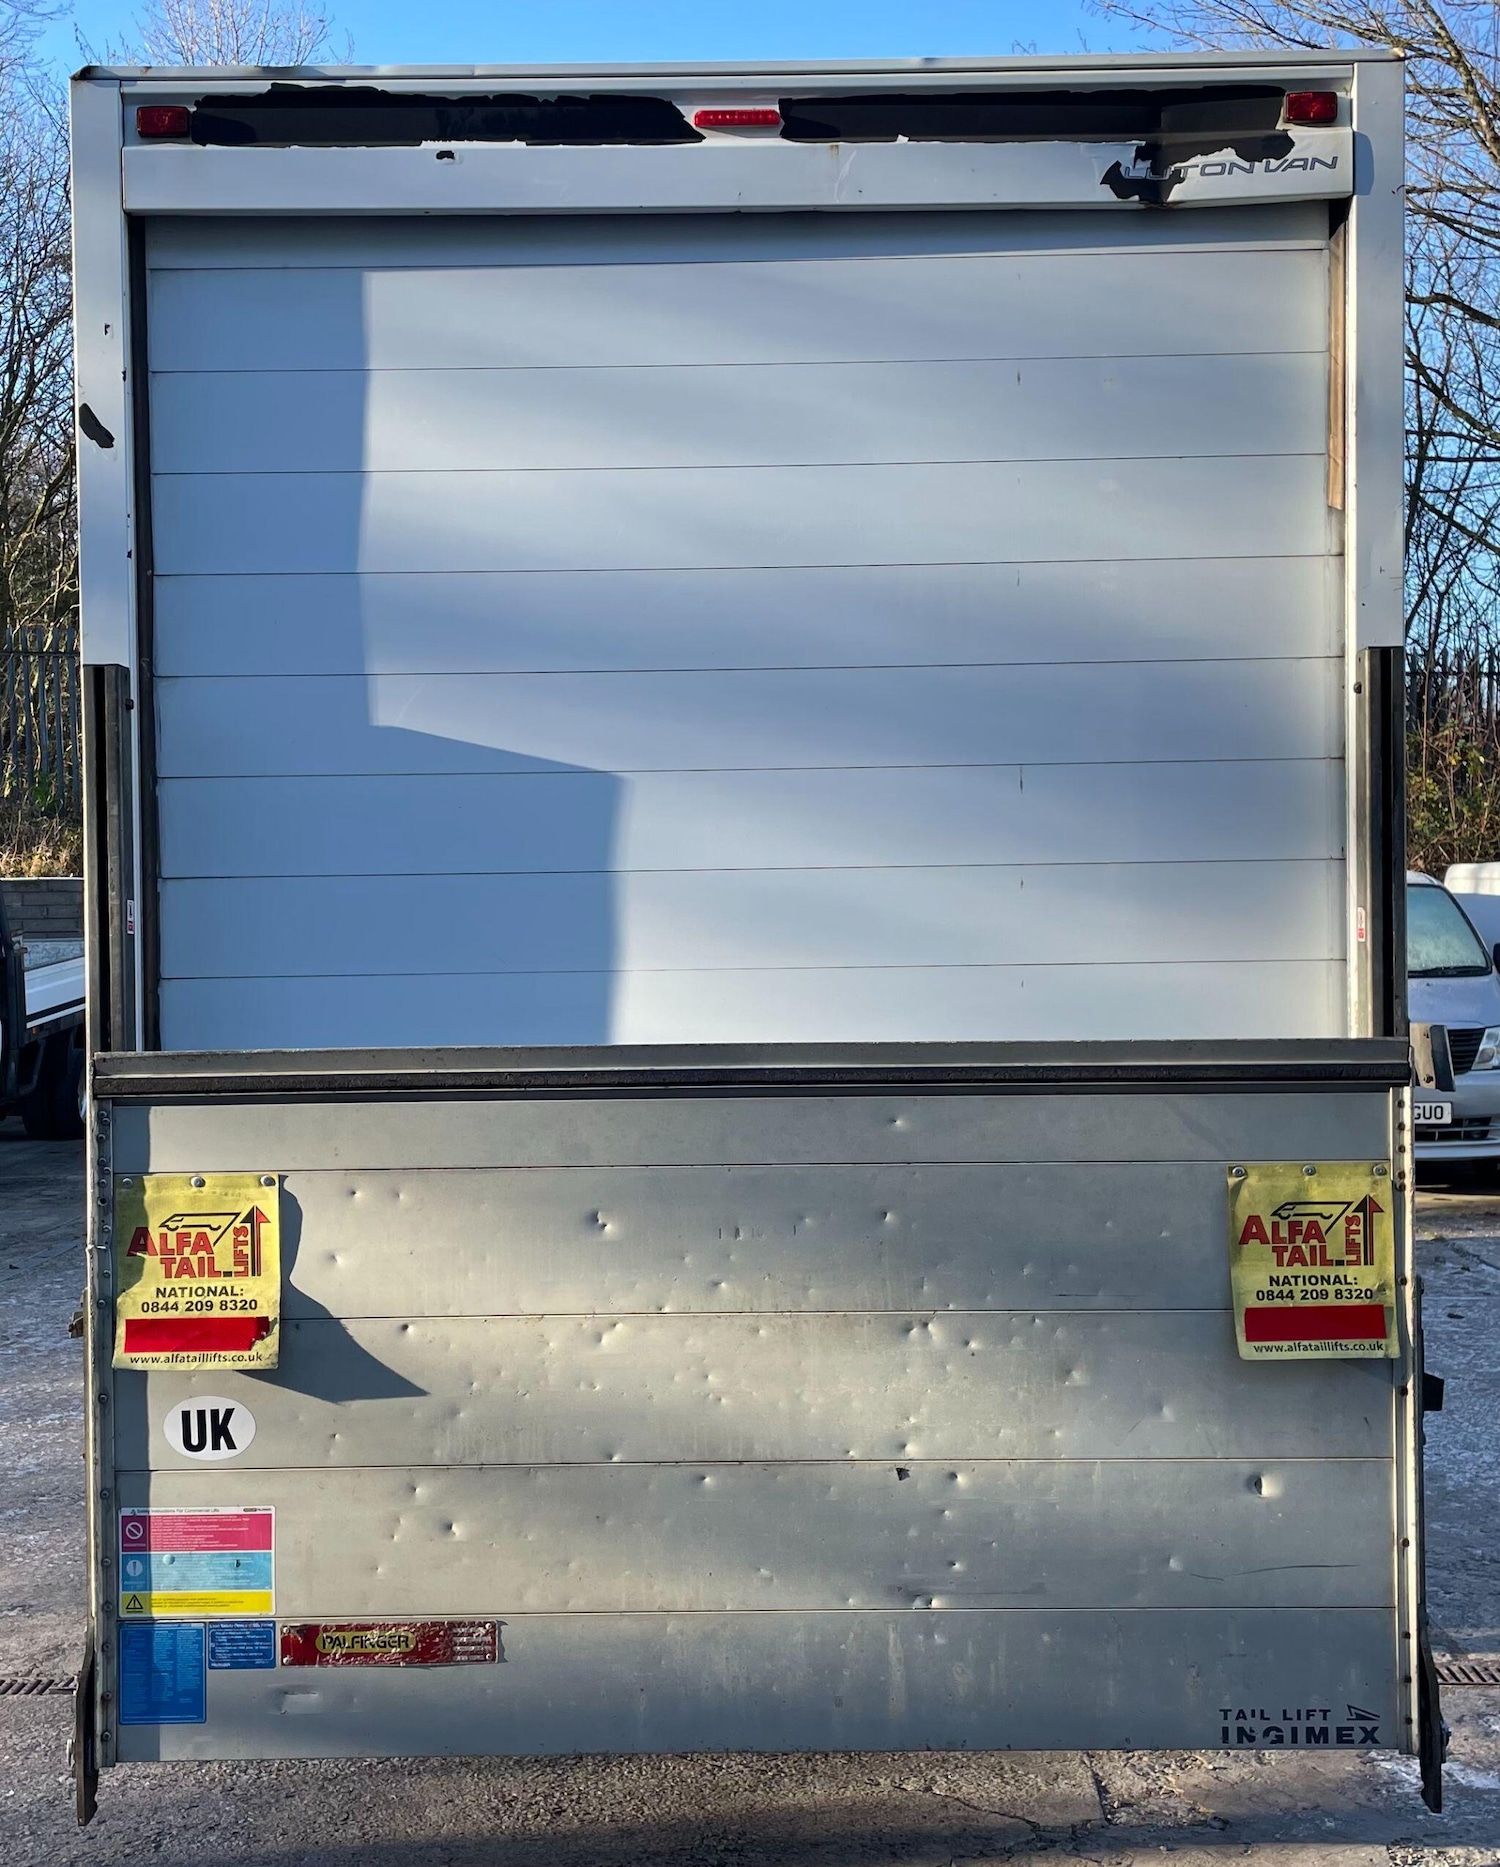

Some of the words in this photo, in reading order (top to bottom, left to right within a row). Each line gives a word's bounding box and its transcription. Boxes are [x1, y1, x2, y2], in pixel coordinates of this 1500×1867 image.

[1264, 156, 1339, 174] VAN
[1414, 1105, 1444, 1120] GUO
[1239, 1215, 1327, 1246] ALFA
[126, 1226, 215, 1257] ALFA
[1345, 1214, 1362, 1267] LIFTS
[232, 1225, 249, 1278] LIFTS
[1271, 1245, 1336, 1267] TAIL
[160, 1257, 222, 1279] TAIL
[1269, 1274, 1359, 1287] NATIONAL:
[155, 1286, 244, 1298] NATIONAL:
[1256, 1289, 1295, 1301] 0844
[1300, 1289, 1329, 1300] 209
[1334, 1288, 1373, 1300] 8320
[141, 1301, 179, 1313] 0844
[185, 1301, 214, 1312] 209
[219, 1299, 258, 1311] 8320
[1253, 1341, 1385, 1353] www.alfataillifts.co.uk
[130, 1353, 263, 1364] www.alfataillifts.co.uk
[181, 1408, 237, 1452] UK
[322, 1633, 410, 1649] PALFINGER
[1219, 1709, 1270, 1721] TAIL
[1282, 1709, 1331, 1721] LIFT
[1221, 1726, 1381, 1745] INGIMEX
